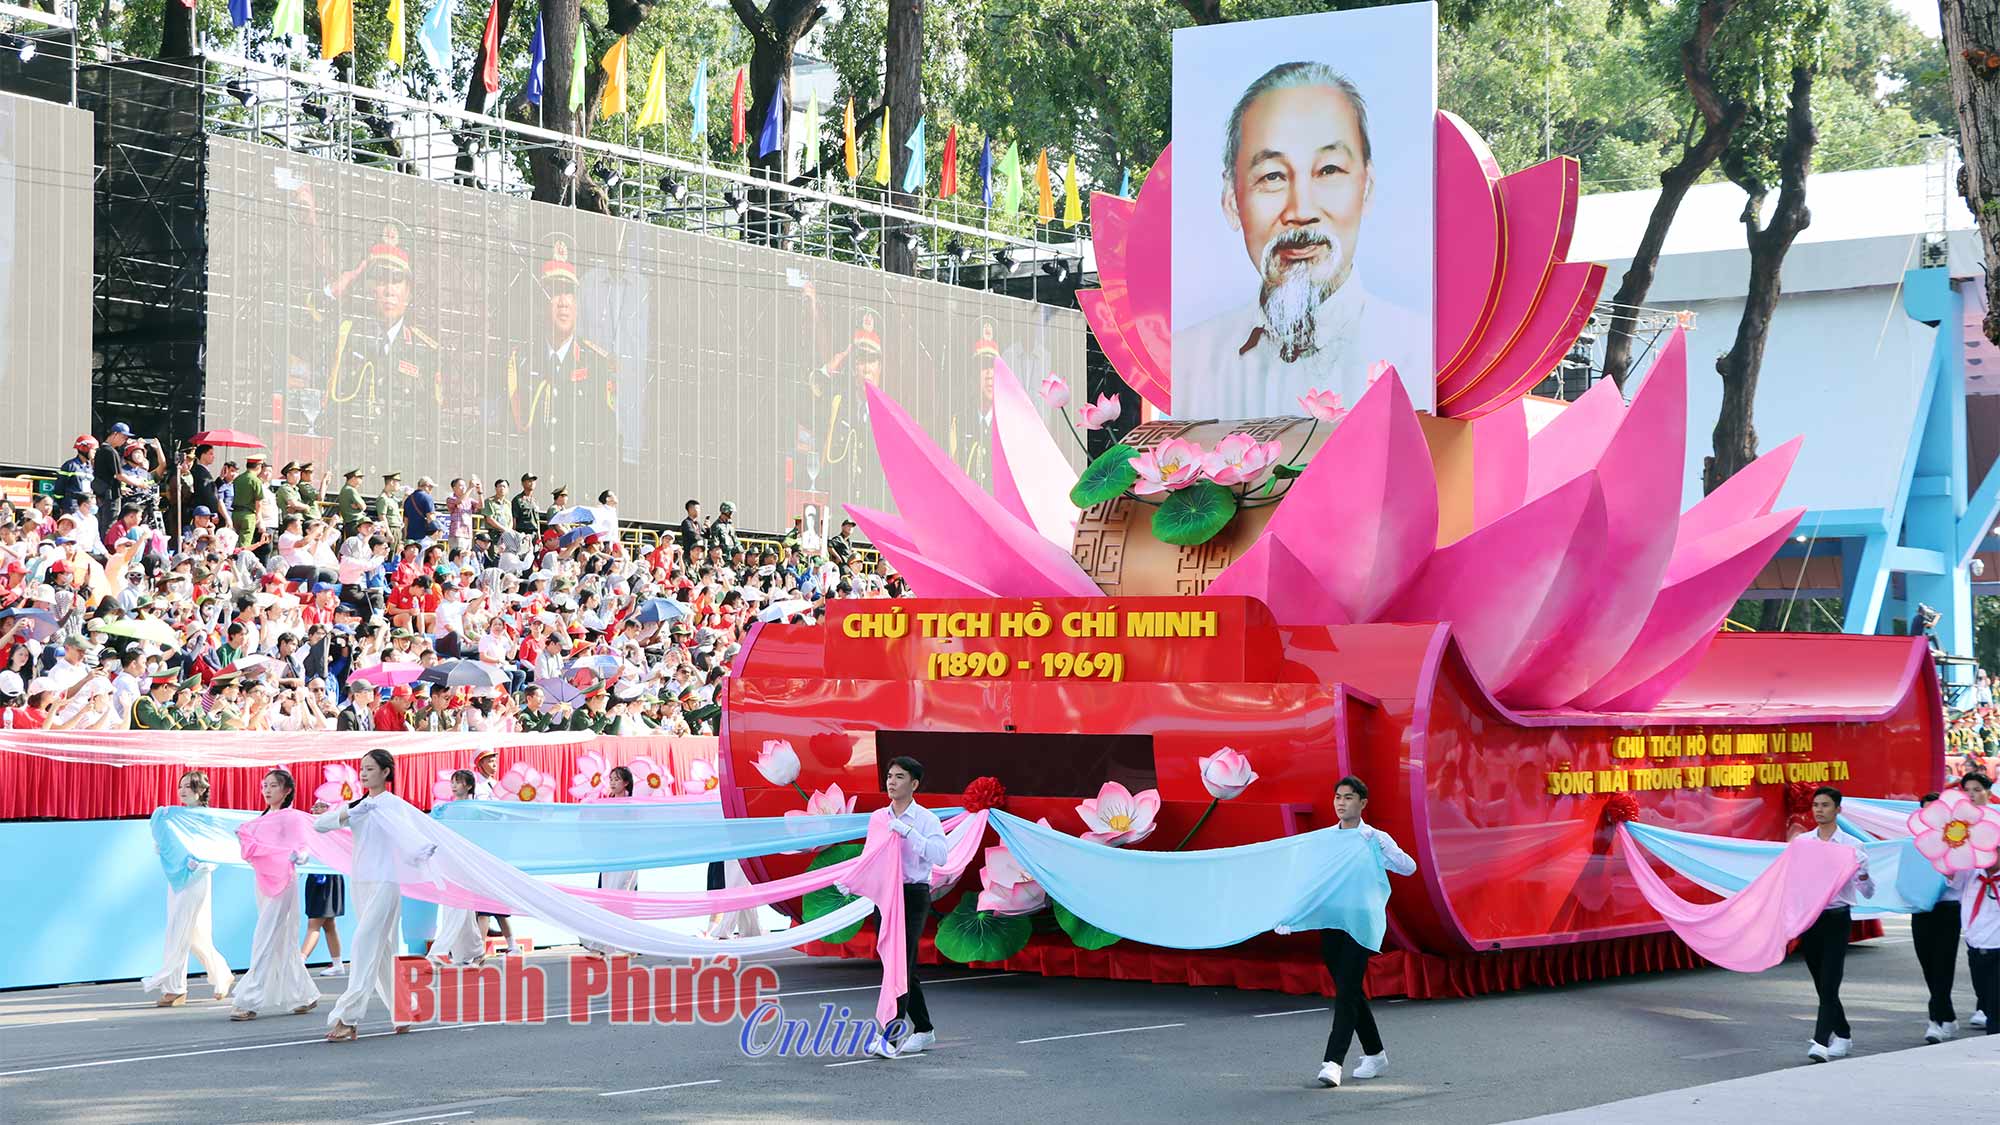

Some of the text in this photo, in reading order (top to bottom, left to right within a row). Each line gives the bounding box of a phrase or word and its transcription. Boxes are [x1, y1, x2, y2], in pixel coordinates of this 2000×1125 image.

[43, 483, 56, 491] EX
[842, 601, 1218, 643] CHỦ TỊCH HỒ CHÍ MINH
[927, 652, 1009, 681] (1890
[1041, 652, 1125, 682] 1969)
[1614, 729, 1645, 758] CHỦ
[1650, 735, 1682, 762] TỊCH
[1684, 726, 1707, 756] HỒ
[1711, 728, 1732, 756] CHÍ
[1735, 733, 1768, 754] MINH
[1548, 761, 1594, 795] SỐNG
[1631, 767, 1683, 791] TRONG
[1709, 760, 1755, 791] NGHIỆP
[1757, 757, 1785, 784] CỦA
[1788, 757, 1829, 782] CHÚNG
[1832, 760, 1850, 780] TA
